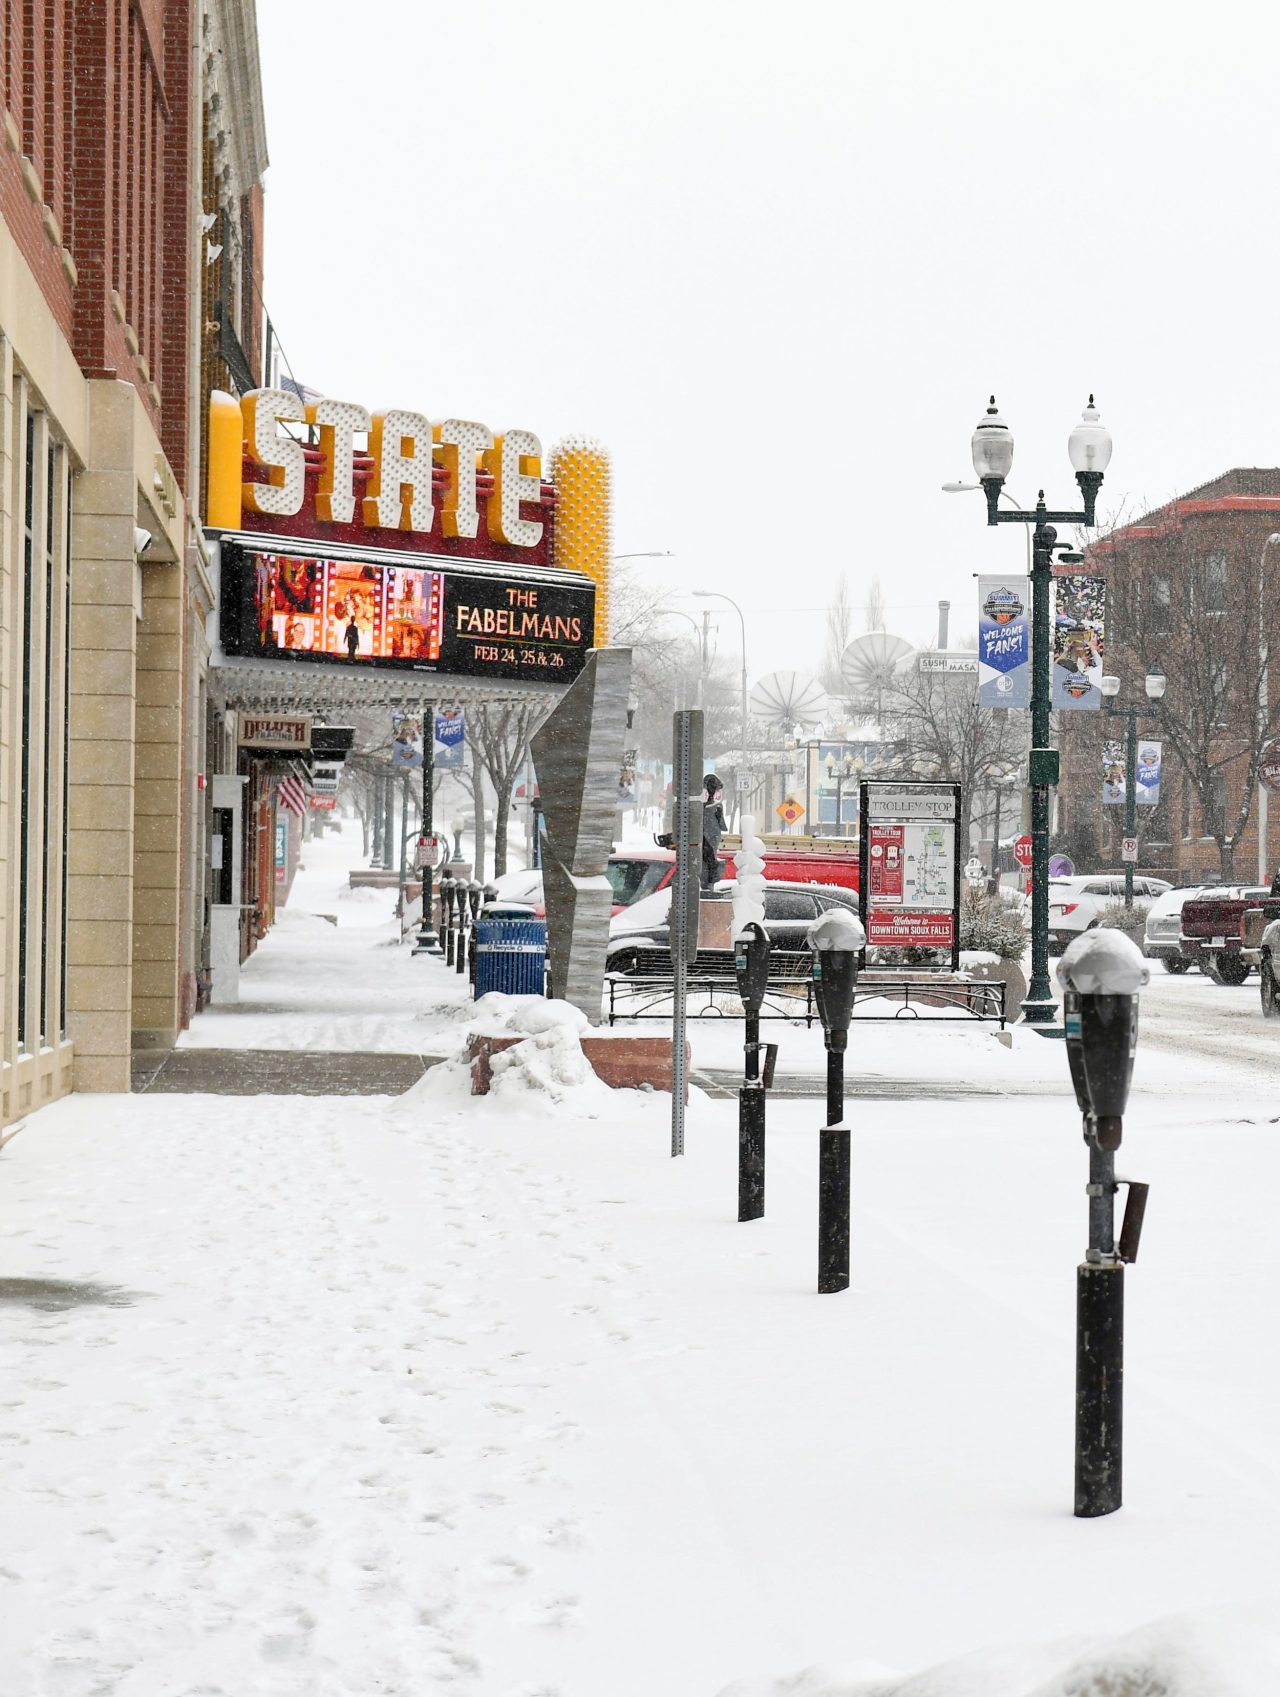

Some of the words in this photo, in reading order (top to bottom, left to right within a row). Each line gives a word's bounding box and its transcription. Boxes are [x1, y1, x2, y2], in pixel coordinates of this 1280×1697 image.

[241, 388, 544, 548] STATE
[505, 588, 538, 608] THE
[457, 605, 582, 642] FABELMANS
[983, 624, 1024, 641] WELCOME
[986, 635, 1023, 659] FANS!
[474, 645, 499, 661] FEB
[501, 648, 518, 665] 24,
[521, 652, 536, 665] 25
[537, 652, 548, 667] &
[550, 653, 564, 668] 26
[922, 659, 948, 667] SUSHI
[949, 664, 977, 672] MASA
[244, 720, 306, 741] DULUTH
[739, 781, 750, 789] 15
[872, 801, 923, 811] TROLLEY
[925, 802, 952, 812] STOP
[1016, 844, 1032, 857] ST
[892, 915, 922, 926] Welcome
[871, 925, 910, 935] DOWNTOWN
[910, 925, 930, 935] SIOUX
[930, 925, 950, 935] FALLS
[493, 944, 516, 953] Recycle
